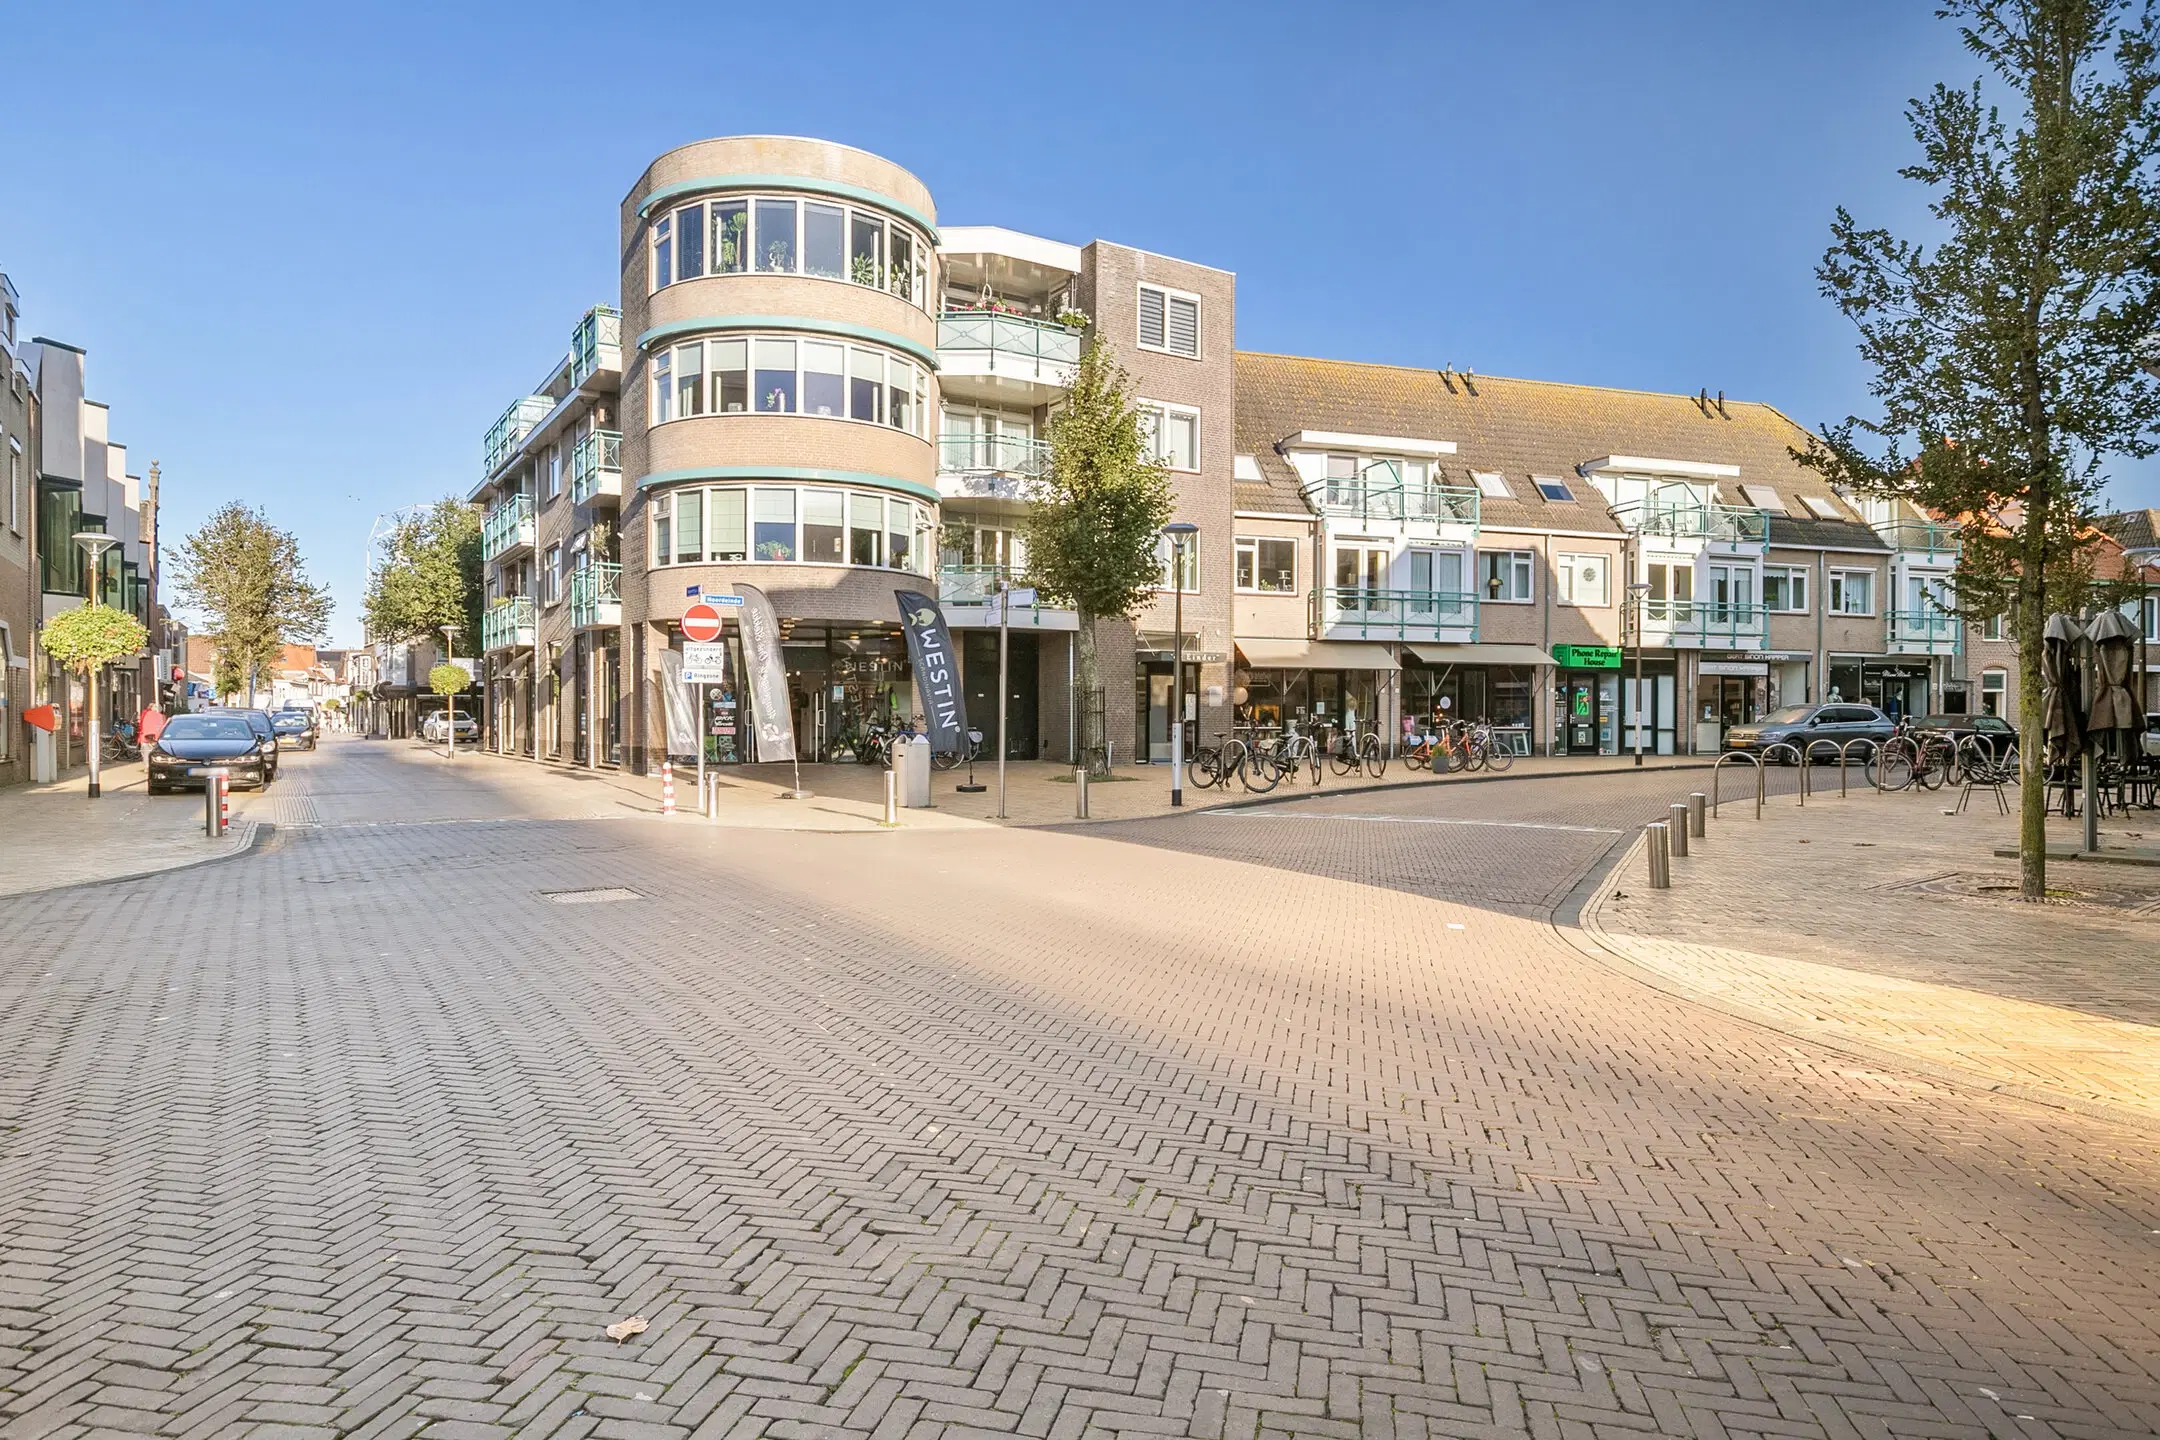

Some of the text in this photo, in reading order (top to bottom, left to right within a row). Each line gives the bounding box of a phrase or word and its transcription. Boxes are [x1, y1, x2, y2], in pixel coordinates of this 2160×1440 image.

[707, 596, 741, 604] Noordeinde
[1571, 648, 1617, 659] Phone Repair
[1583, 658, 1605, 666] House
[920, 628, 958, 728] WESTIN
